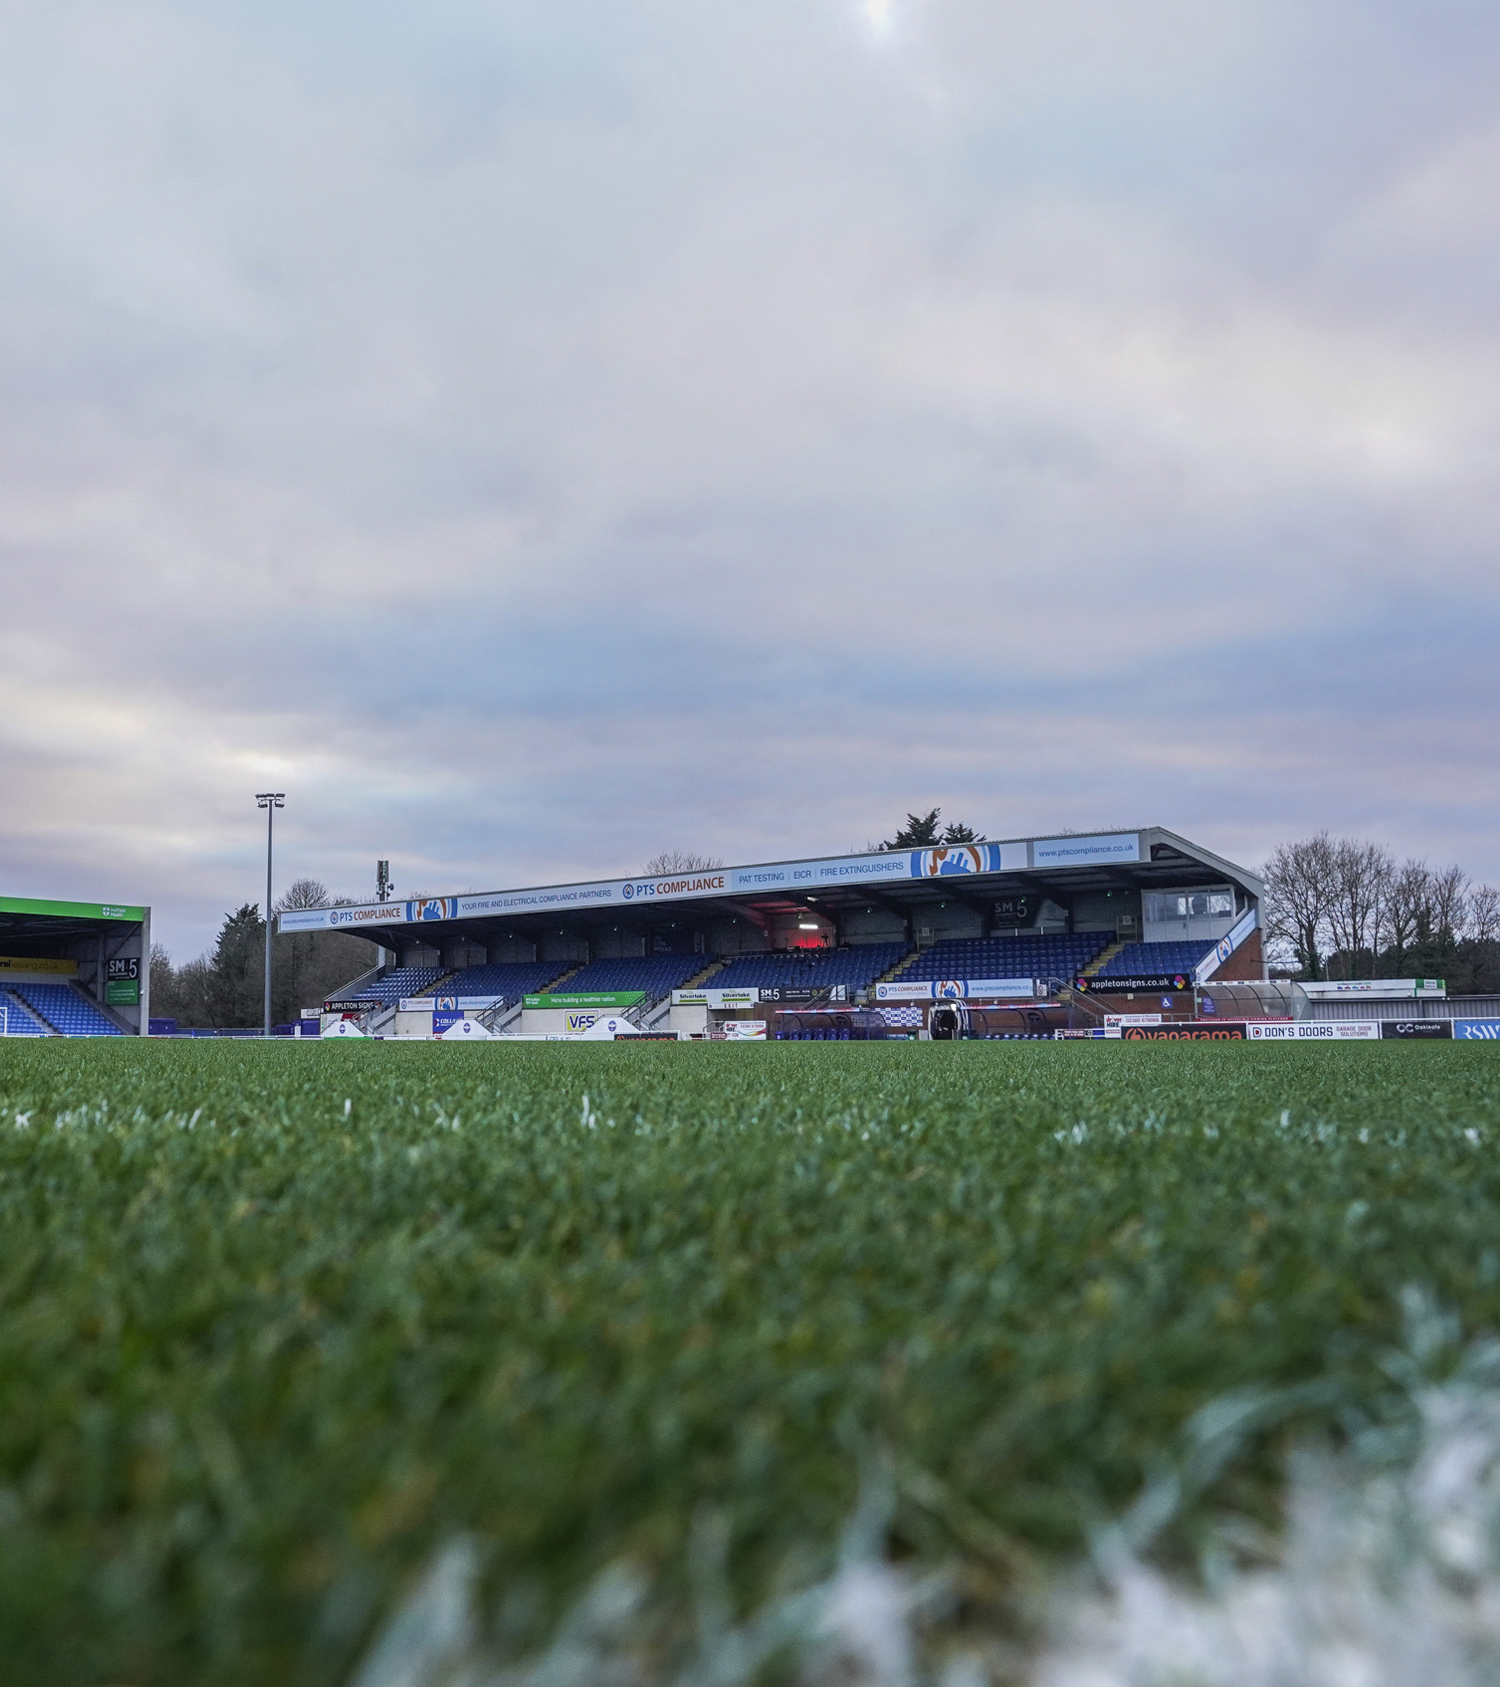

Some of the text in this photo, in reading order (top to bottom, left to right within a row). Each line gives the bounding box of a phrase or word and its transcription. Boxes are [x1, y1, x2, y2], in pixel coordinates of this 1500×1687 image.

[1038, 843, 1134, 857] www.ptscompliance.co.uk
[739, 861, 904, 884] PAT TESTING EICR FIRE EXTINGUISHERS
[636, 876, 724, 896] PTS COMPLIANCE
[462, 889, 612, 911] YOUR FIRE AND ELECTRICAL COMPLIANCE PARTNERS
[994, 901, 1013, 913] SM
[340, 912, 353, 922] PTS
[354, 907, 400, 921] COMPLIANCE
[109, 960, 124, 972] SM
[129, 959, 138, 978] 5
[1091, 978, 1169, 989] appletonsigns.co.uk
[773, 989, 780, 1000] 5
[331, 1002, 358, 1010] APPLETON
[569, 1015, 595, 1028] VFS
[1265, 1027, 1295, 1037] DON'S
[1298, 1027, 1333, 1037] DOORS
